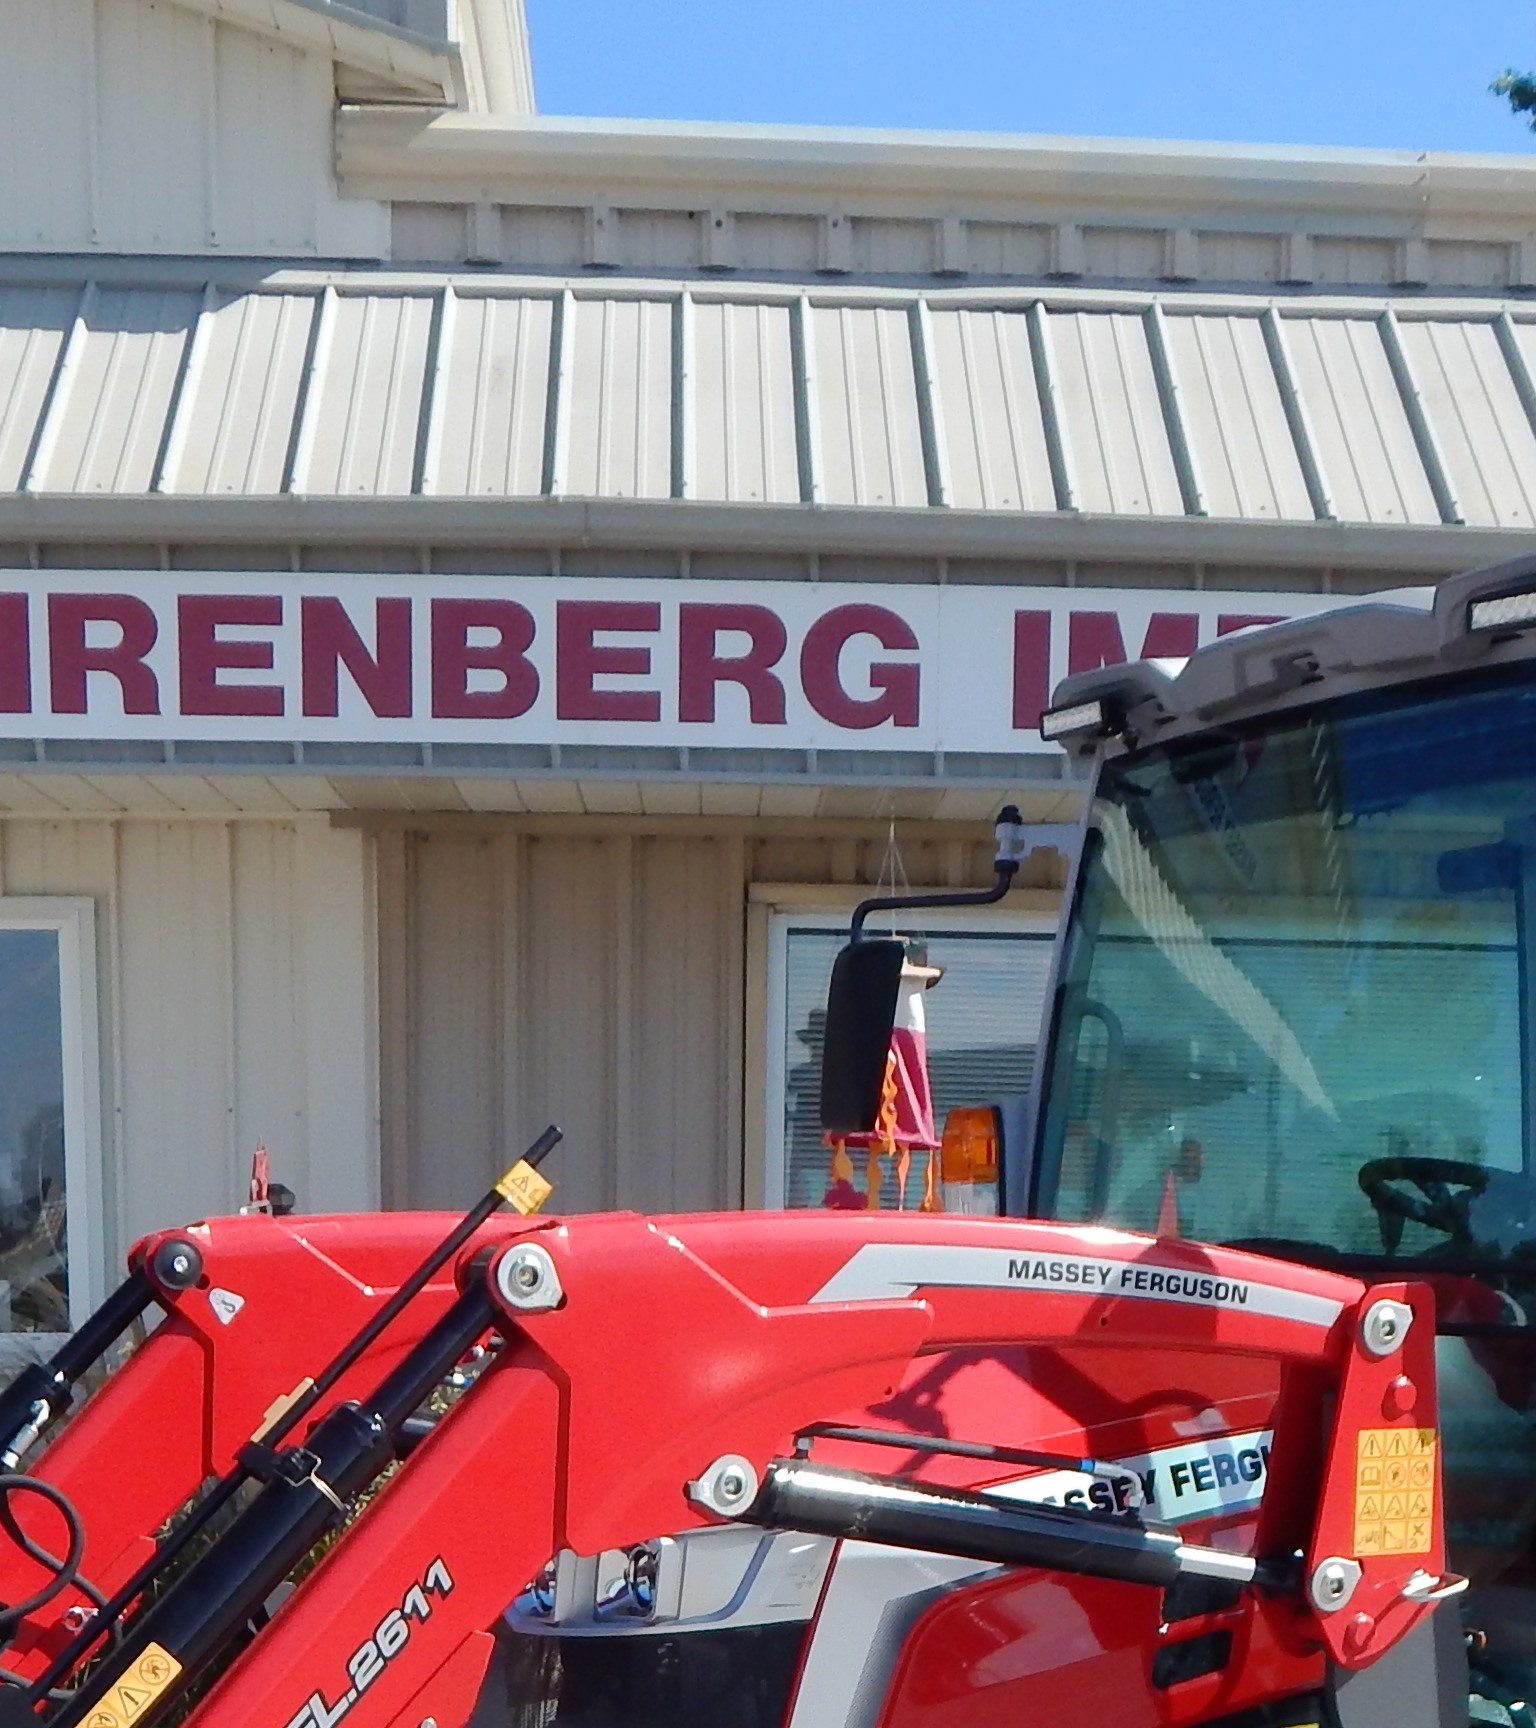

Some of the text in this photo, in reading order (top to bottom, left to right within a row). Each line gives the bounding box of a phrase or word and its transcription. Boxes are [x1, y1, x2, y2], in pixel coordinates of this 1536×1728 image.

[1012, 610, 1293, 729] IM
[1007, 1258, 1249, 1304] MASSEY FERGUSON
[1041, 1468, 1156, 1514] SSEY
